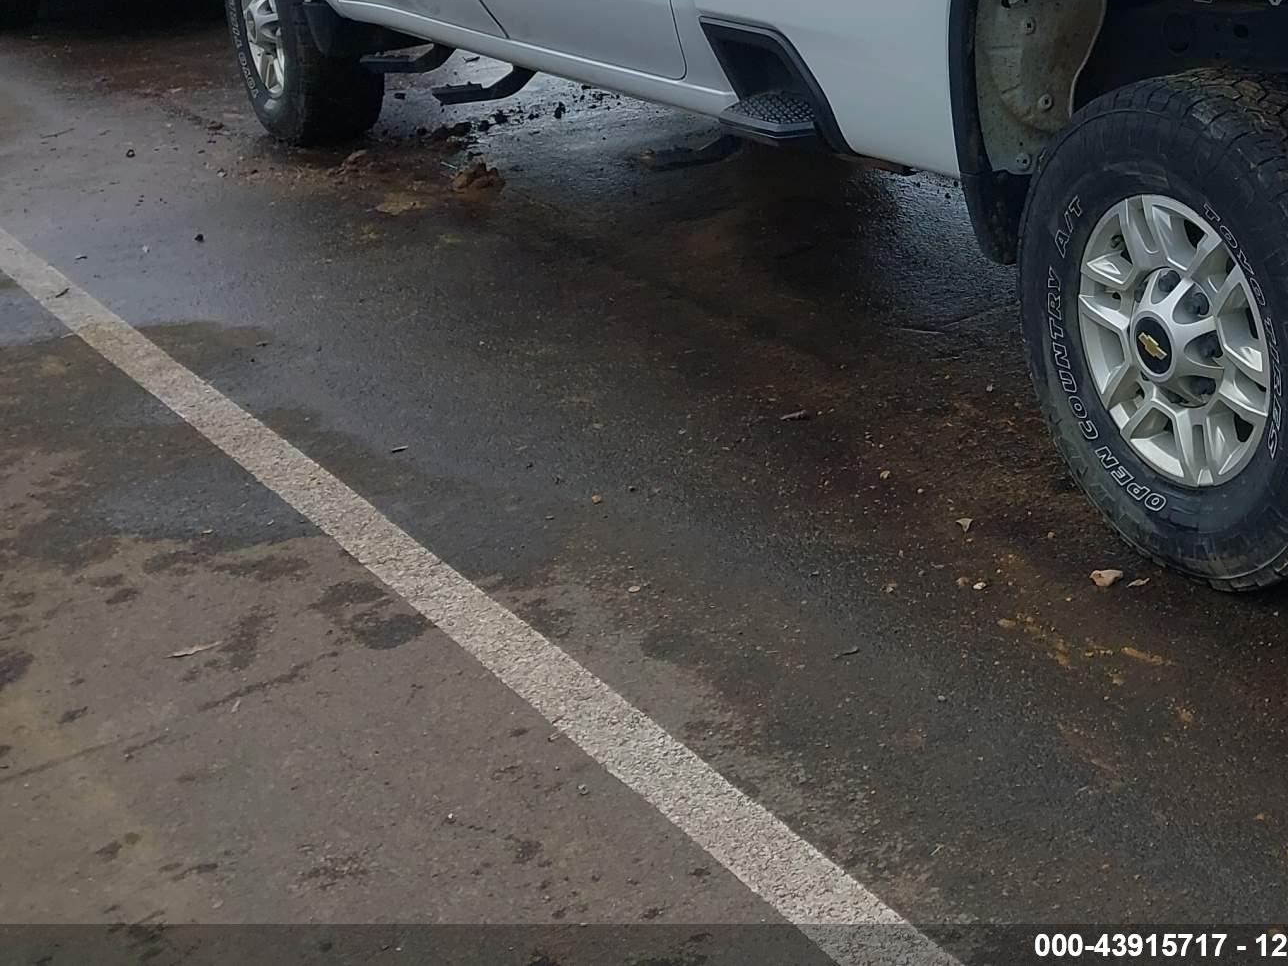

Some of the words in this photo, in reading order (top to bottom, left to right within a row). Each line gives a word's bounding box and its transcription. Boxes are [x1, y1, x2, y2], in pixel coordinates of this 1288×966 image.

[1053, 194, 1084, 259] A/T
[1047, 265, 1099, 440] COUNTRY
[1203, 202, 1266, 307] TOYO
[1263, 316, 1282, 460] TIRES
[1095, 446, 1166, 512] OPEN
